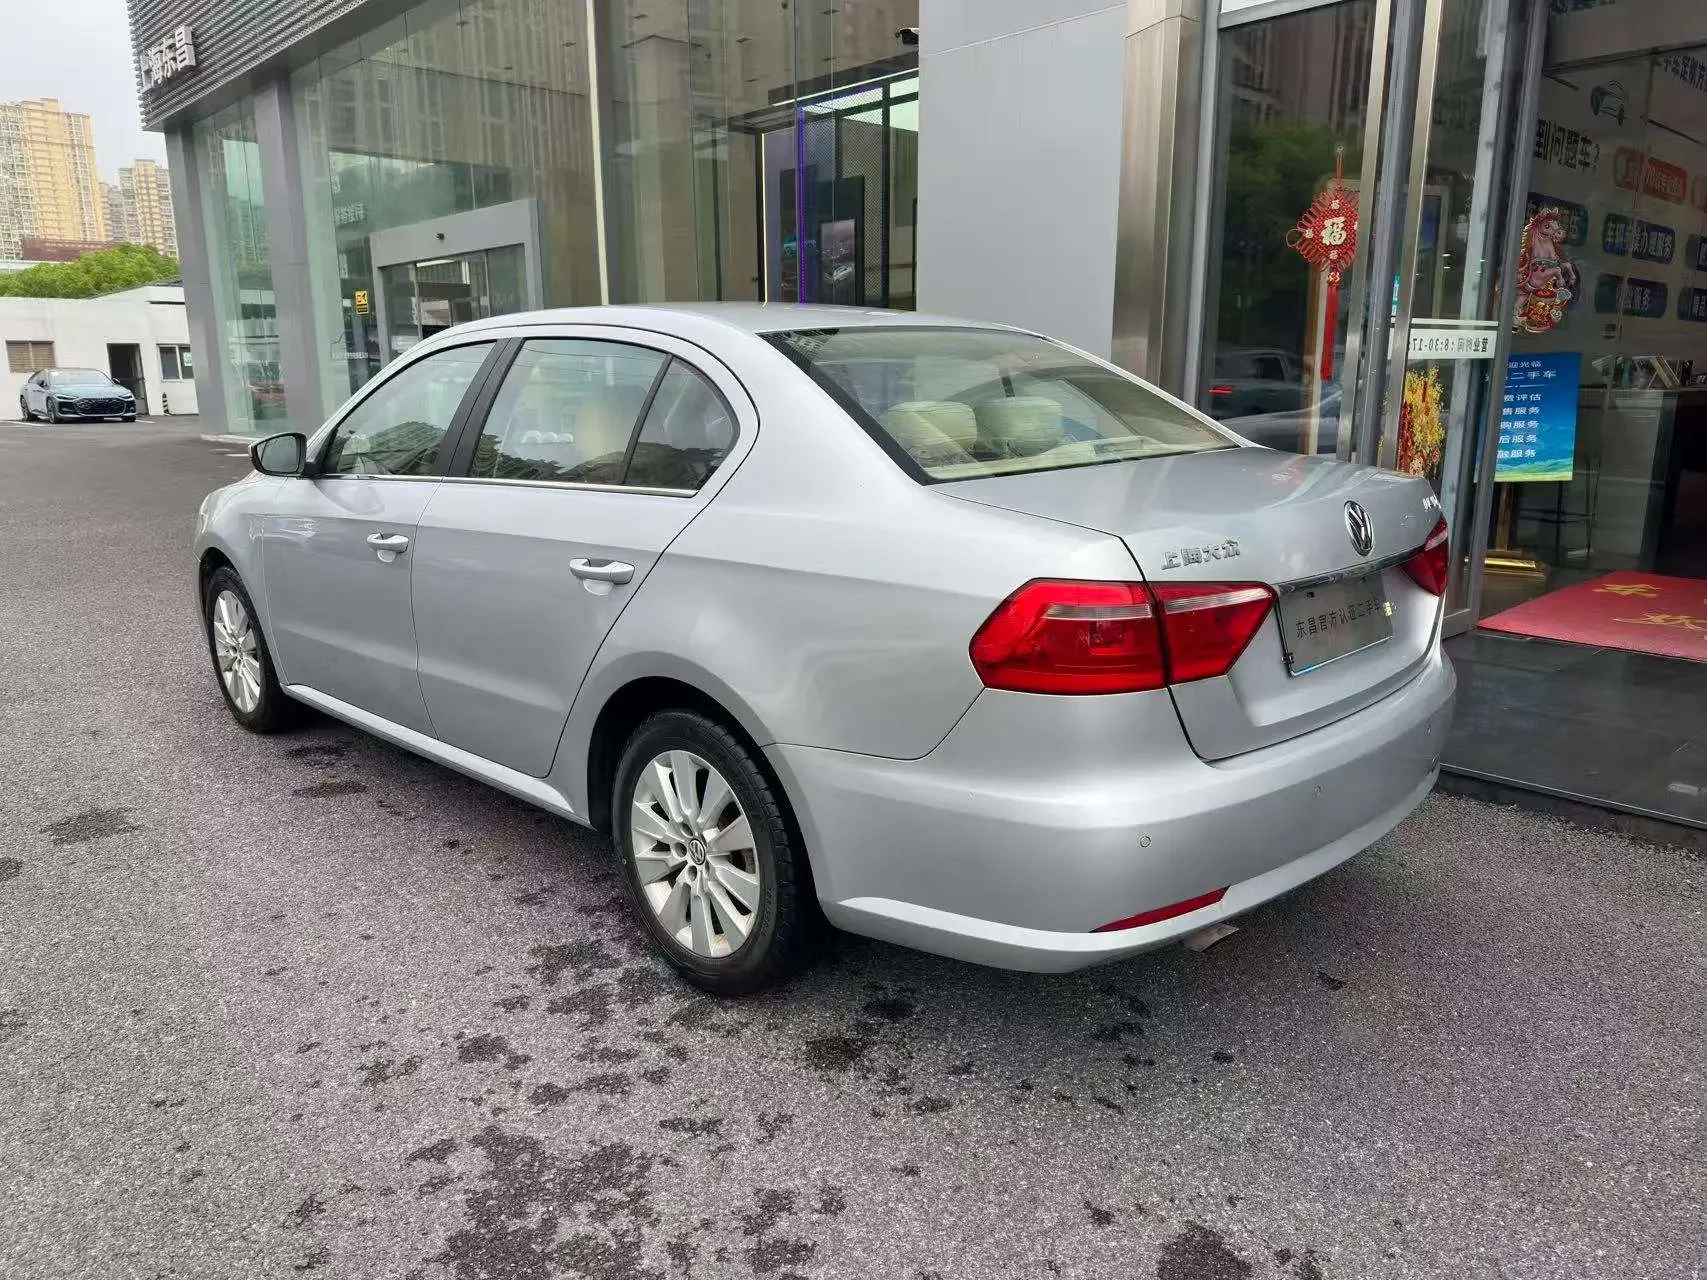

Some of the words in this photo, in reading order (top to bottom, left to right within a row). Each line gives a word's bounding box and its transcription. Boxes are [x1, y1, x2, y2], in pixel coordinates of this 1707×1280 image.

[1320, 216, 1347, 246] 福
[1505, 370, 1557, 380] 二手车
